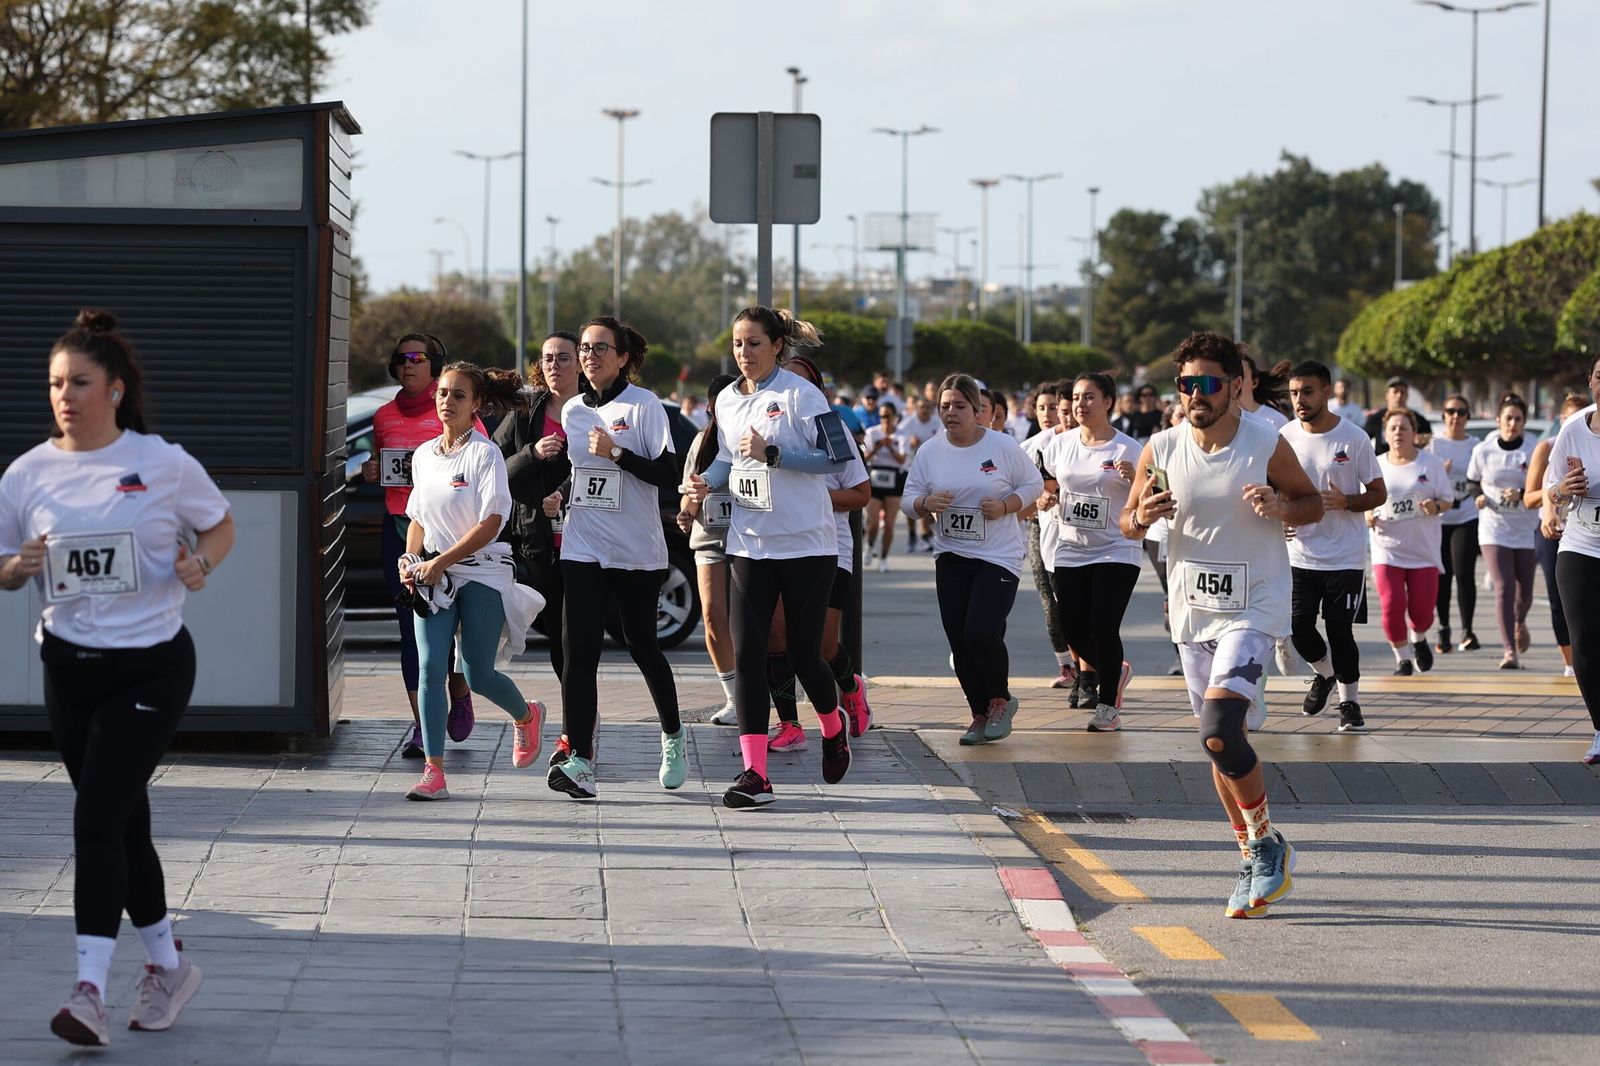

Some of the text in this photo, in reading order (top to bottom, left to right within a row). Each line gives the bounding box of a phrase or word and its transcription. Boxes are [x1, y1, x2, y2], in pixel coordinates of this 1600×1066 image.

[588, 477, 607, 496] 57
[739, 478, 758, 497] 441
[1073, 502, 1099, 519] 465
[1392, 499, 1414, 514] 232
[951, 513, 974, 530] 217
[67, 547, 115, 577] 467
[1197, 572, 1233, 596] 454
